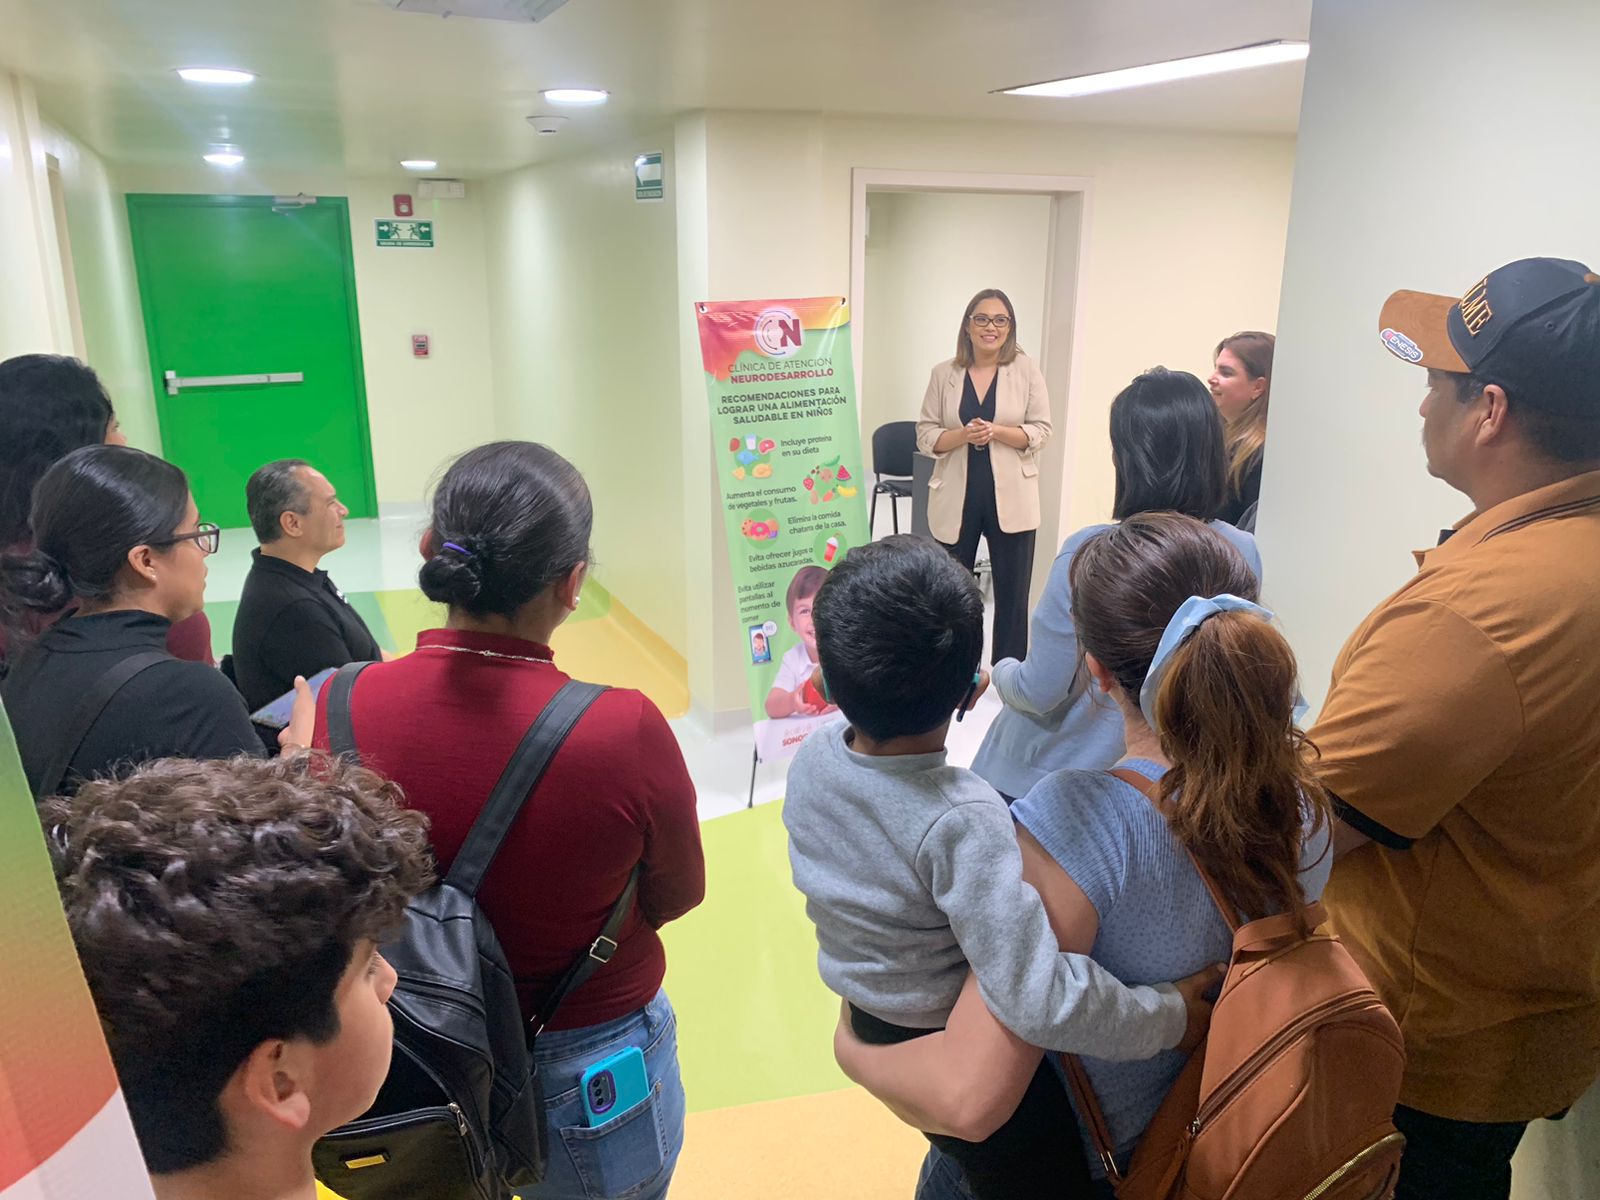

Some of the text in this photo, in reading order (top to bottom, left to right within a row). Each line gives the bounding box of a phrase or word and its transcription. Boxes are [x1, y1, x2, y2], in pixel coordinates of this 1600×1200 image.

[768, 361, 781, 370] DE
[731, 368, 834, 384] NEURODESARROLLO
[721, 386, 840, 404] RECOMENDACIONES PARA
[717, 394, 847, 415] LOGRAR UNA ALIMENTACIÓN
[733, 406, 833, 424] SALUDABLE EN NIÑOS
[781, 438, 806, 447] Incluye
[755, 489, 762, 497] el
[763, 486, 796, 496] consumo
[727, 502, 736, 510] de
[736, 499, 768, 510] vegetales
[768, 499, 773, 507] y
[812, 513, 817, 521] la
[818, 511, 841, 520] comida
[814, 522, 823, 530] de
[823, 521, 830, 529] la
[748, 553, 765, 563] Evita
[765, 550, 791, 559] ofrecer
[749, 562, 777, 573] bebidas
[752, 580, 775, 591] utilizar
[766, 591, 773, 599] al
[771, 600, 781, 608] de
[782, 733, 808, 747] SONO
